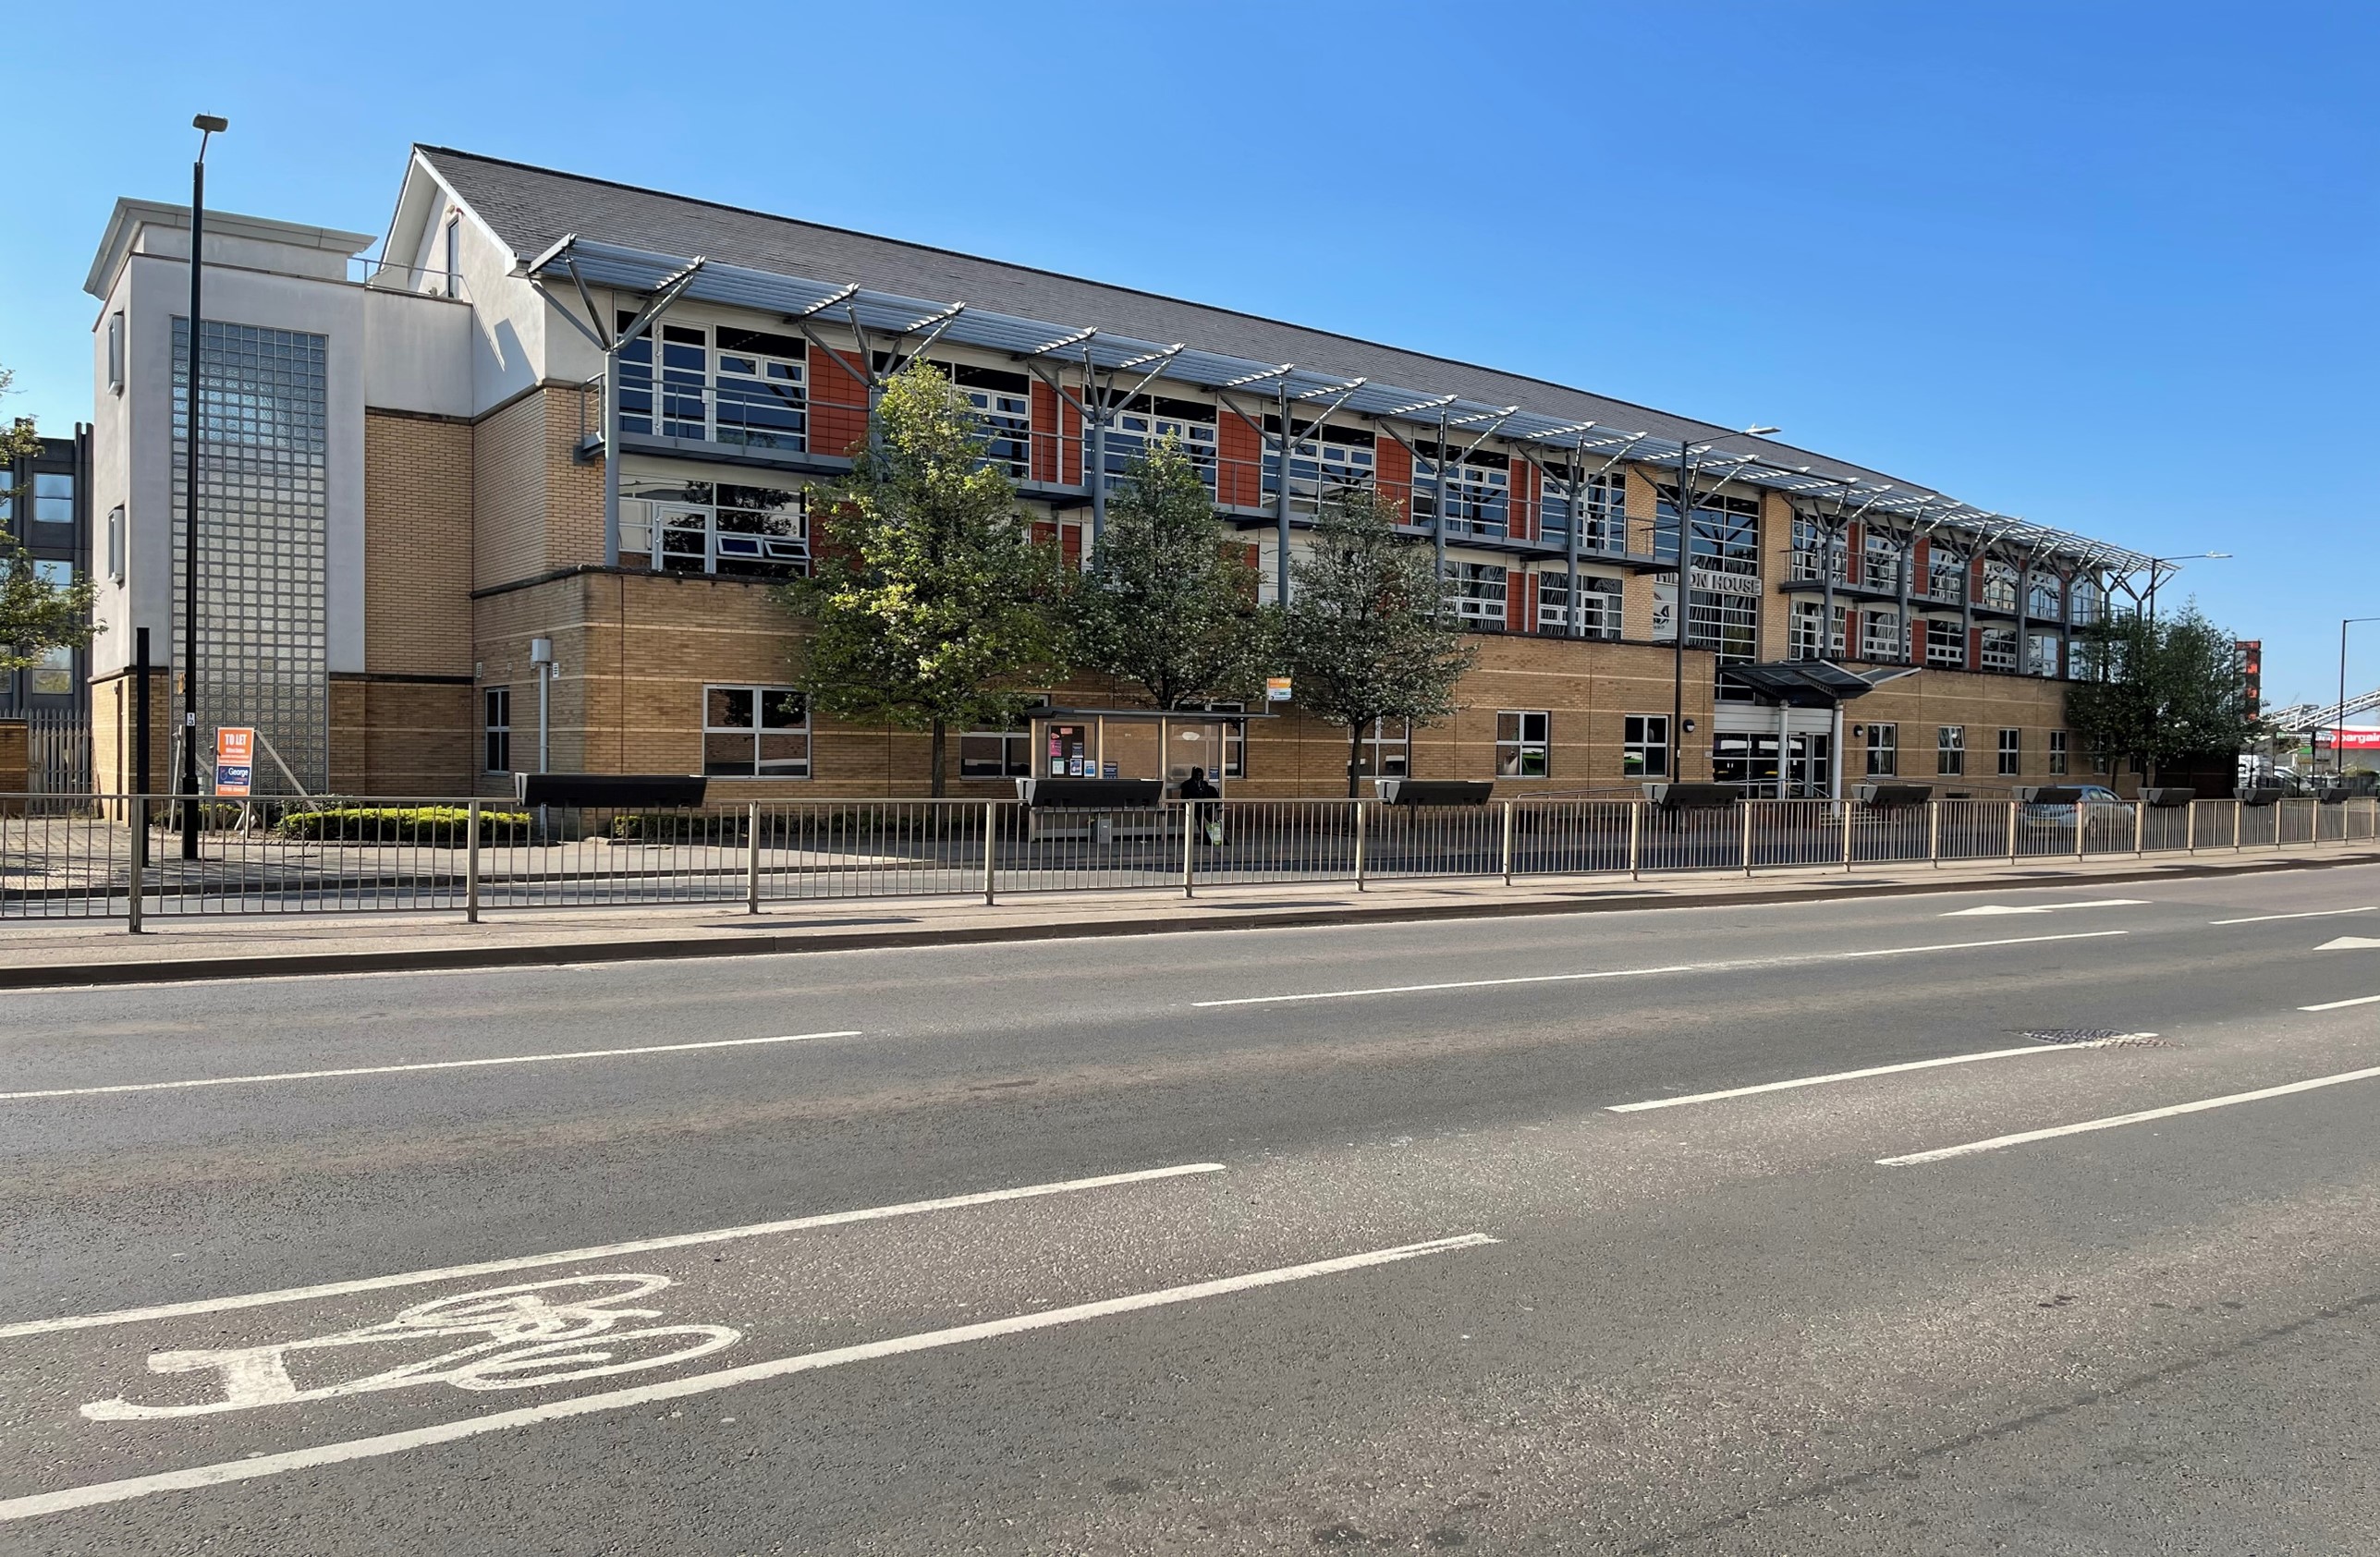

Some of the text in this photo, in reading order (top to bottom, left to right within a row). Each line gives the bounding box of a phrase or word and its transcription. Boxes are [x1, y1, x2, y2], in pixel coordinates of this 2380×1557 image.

[1656, 572, 1760, 594] HILON HOUSE
[225, 734, 247, 745] TO LET
[228, 768, 249, 777] George
